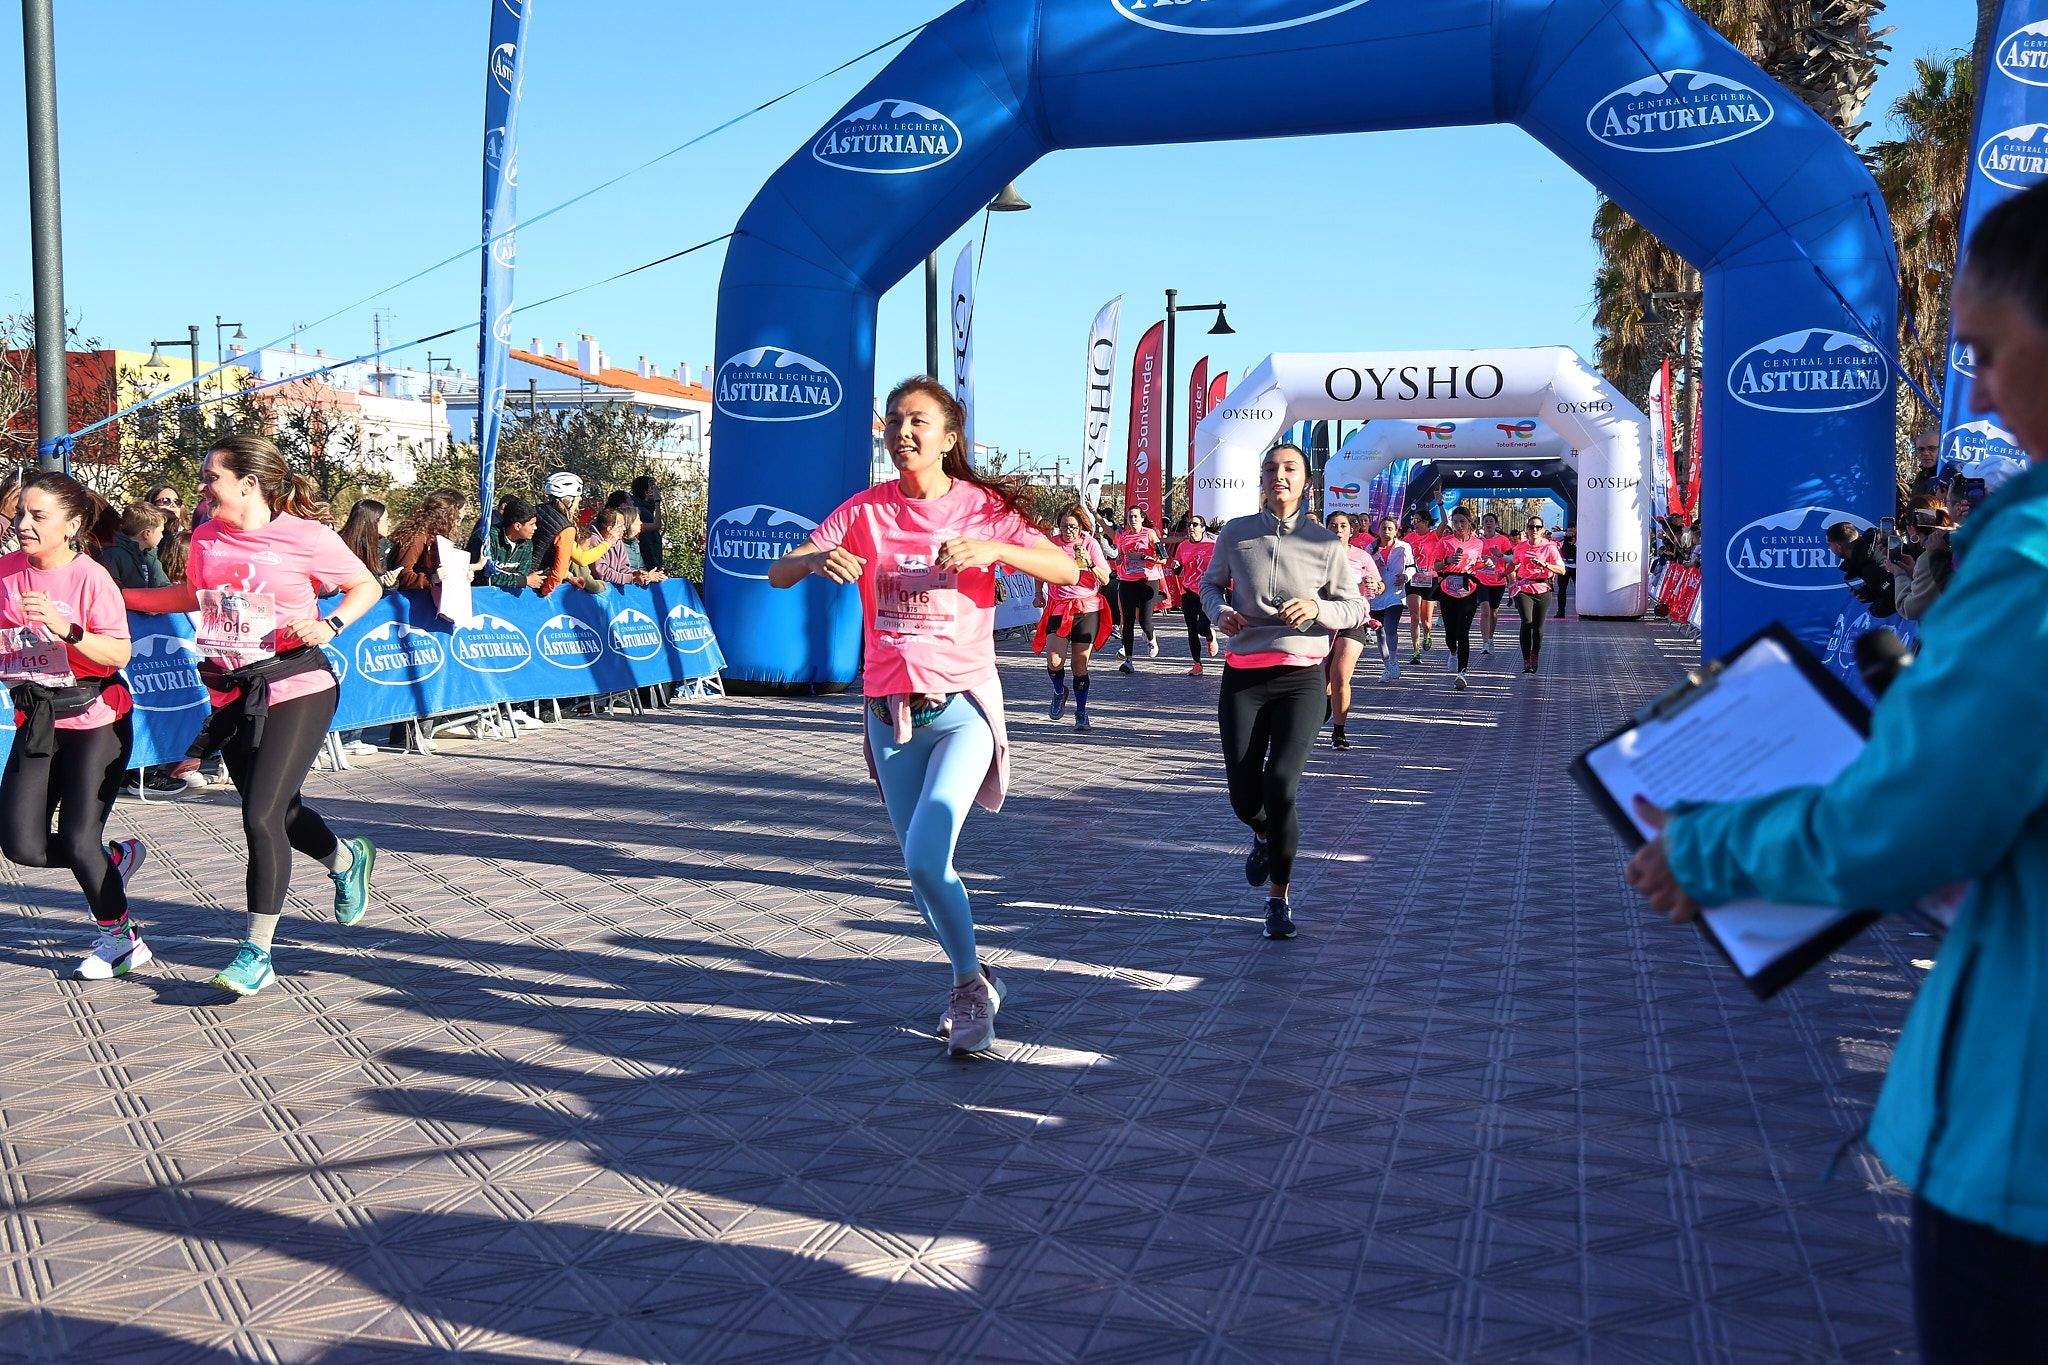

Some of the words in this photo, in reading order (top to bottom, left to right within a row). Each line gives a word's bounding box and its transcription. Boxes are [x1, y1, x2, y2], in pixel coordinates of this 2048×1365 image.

[2023, 40, 2048, 48] CENT
[1628, 96, 1689, 111] CENTRAL
[1694, 93, 1753, 103] LECHERA
[1601, 103, 1763, 138] ASTURIANA
[844, 123, 890, 134] CENTRAL
[894, 123, 945, 132] LECHERA
[820, 131, 950, 156] ASTURIANA
[2004, 144, 2041, 154] CENTRAL
[1985, 144, 2048, 174] ASTURI
[1763, 357, 1823, 368] CENTRAL
[1829, 356, 1878, 365] LECHERA
[732, 371, 774, 381] CENTRAL
[779, 373, 829, 384] LECHERA
[1325, 364, 1504, 402] OYSHO
[1737, 363, 1882, 395] ASTURIANA
[718, 374, 832, 406] ASTURIANA
[1138, 353, 1153, 448] Santander
[1222, 408, 1273, 420] OYSHO
[1556, 401, 1613, 414] OYSHO
[1453, 469, 1542, 478] VOLVO
[1198, 477, 1245, 489] OYSHO
[1587, 477, 1639, 489] OYSHO
[1134, 477, 1149, 512] orts
[724, 529, 767, 538] CENTRAL
[771, 531, 808, 540] LECHE
[1761, 535, 1821, 544] CENTRAL
[711, 530, 796, 560] ASTURIA
[1585, 550, 1638, 563] OYSHO
[1736, 538, 1842, 569] ASTURI
[900, 590, 930, 604] 016
[223, 621, 250, 633] 016
[543, 634, 600, 656] ASTURIANA
[613, 629, 660, 650] ASTURIANA
[457, 636, 530, 660] ASTURIANA
[21, 655, 49, 667] 016
[131, 660, 171, 671] CENTRAL
[363, 647, 440, 674] ASTURIANA
